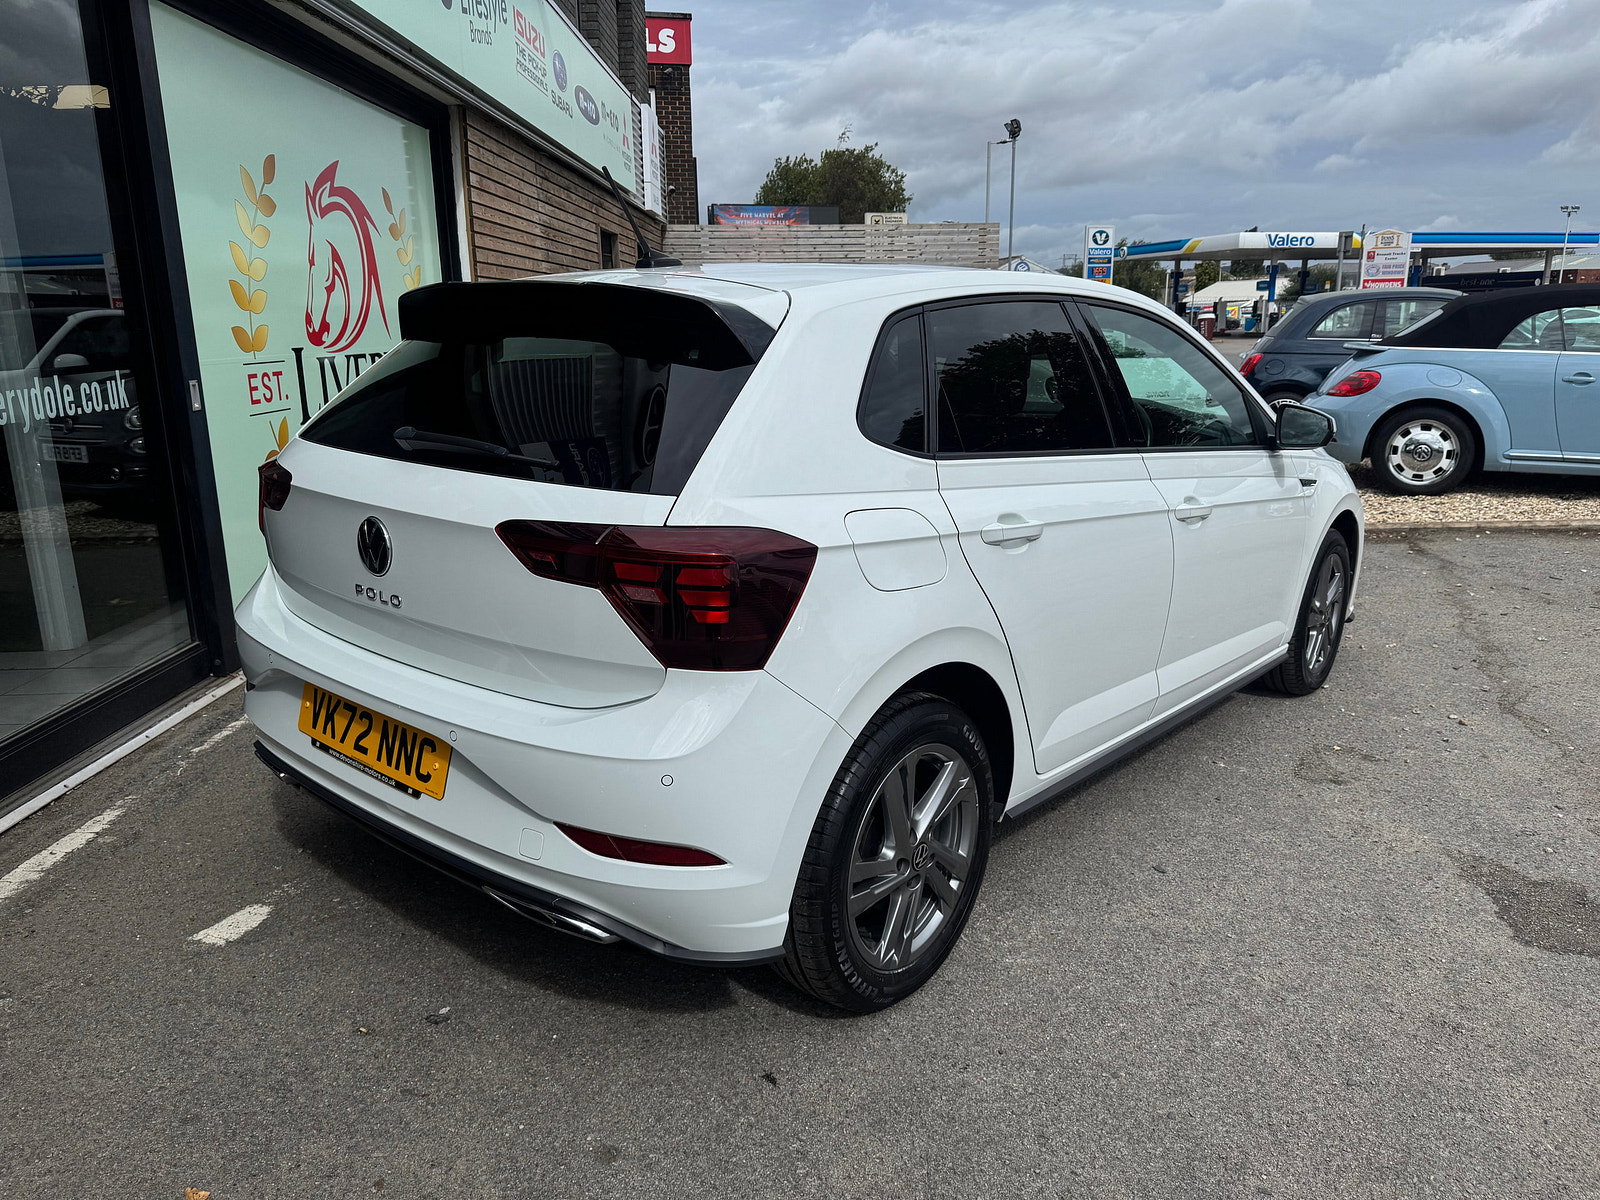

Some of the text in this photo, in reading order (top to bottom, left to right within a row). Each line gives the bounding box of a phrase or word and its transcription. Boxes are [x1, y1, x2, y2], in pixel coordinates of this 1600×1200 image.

[469, 20, 492, 46] Brands
[512, 5, 545, 59] ISUZU
[551, 89, 574, 119] SUBARU
[1267, 233, 1315, 247] Valero
[247, 370, 290, 406] EST.
[291, 347, 389, 425] LIV
[355, 584, 402, 609] POLO
[310, 687, 437, 785] VK72 NNC
